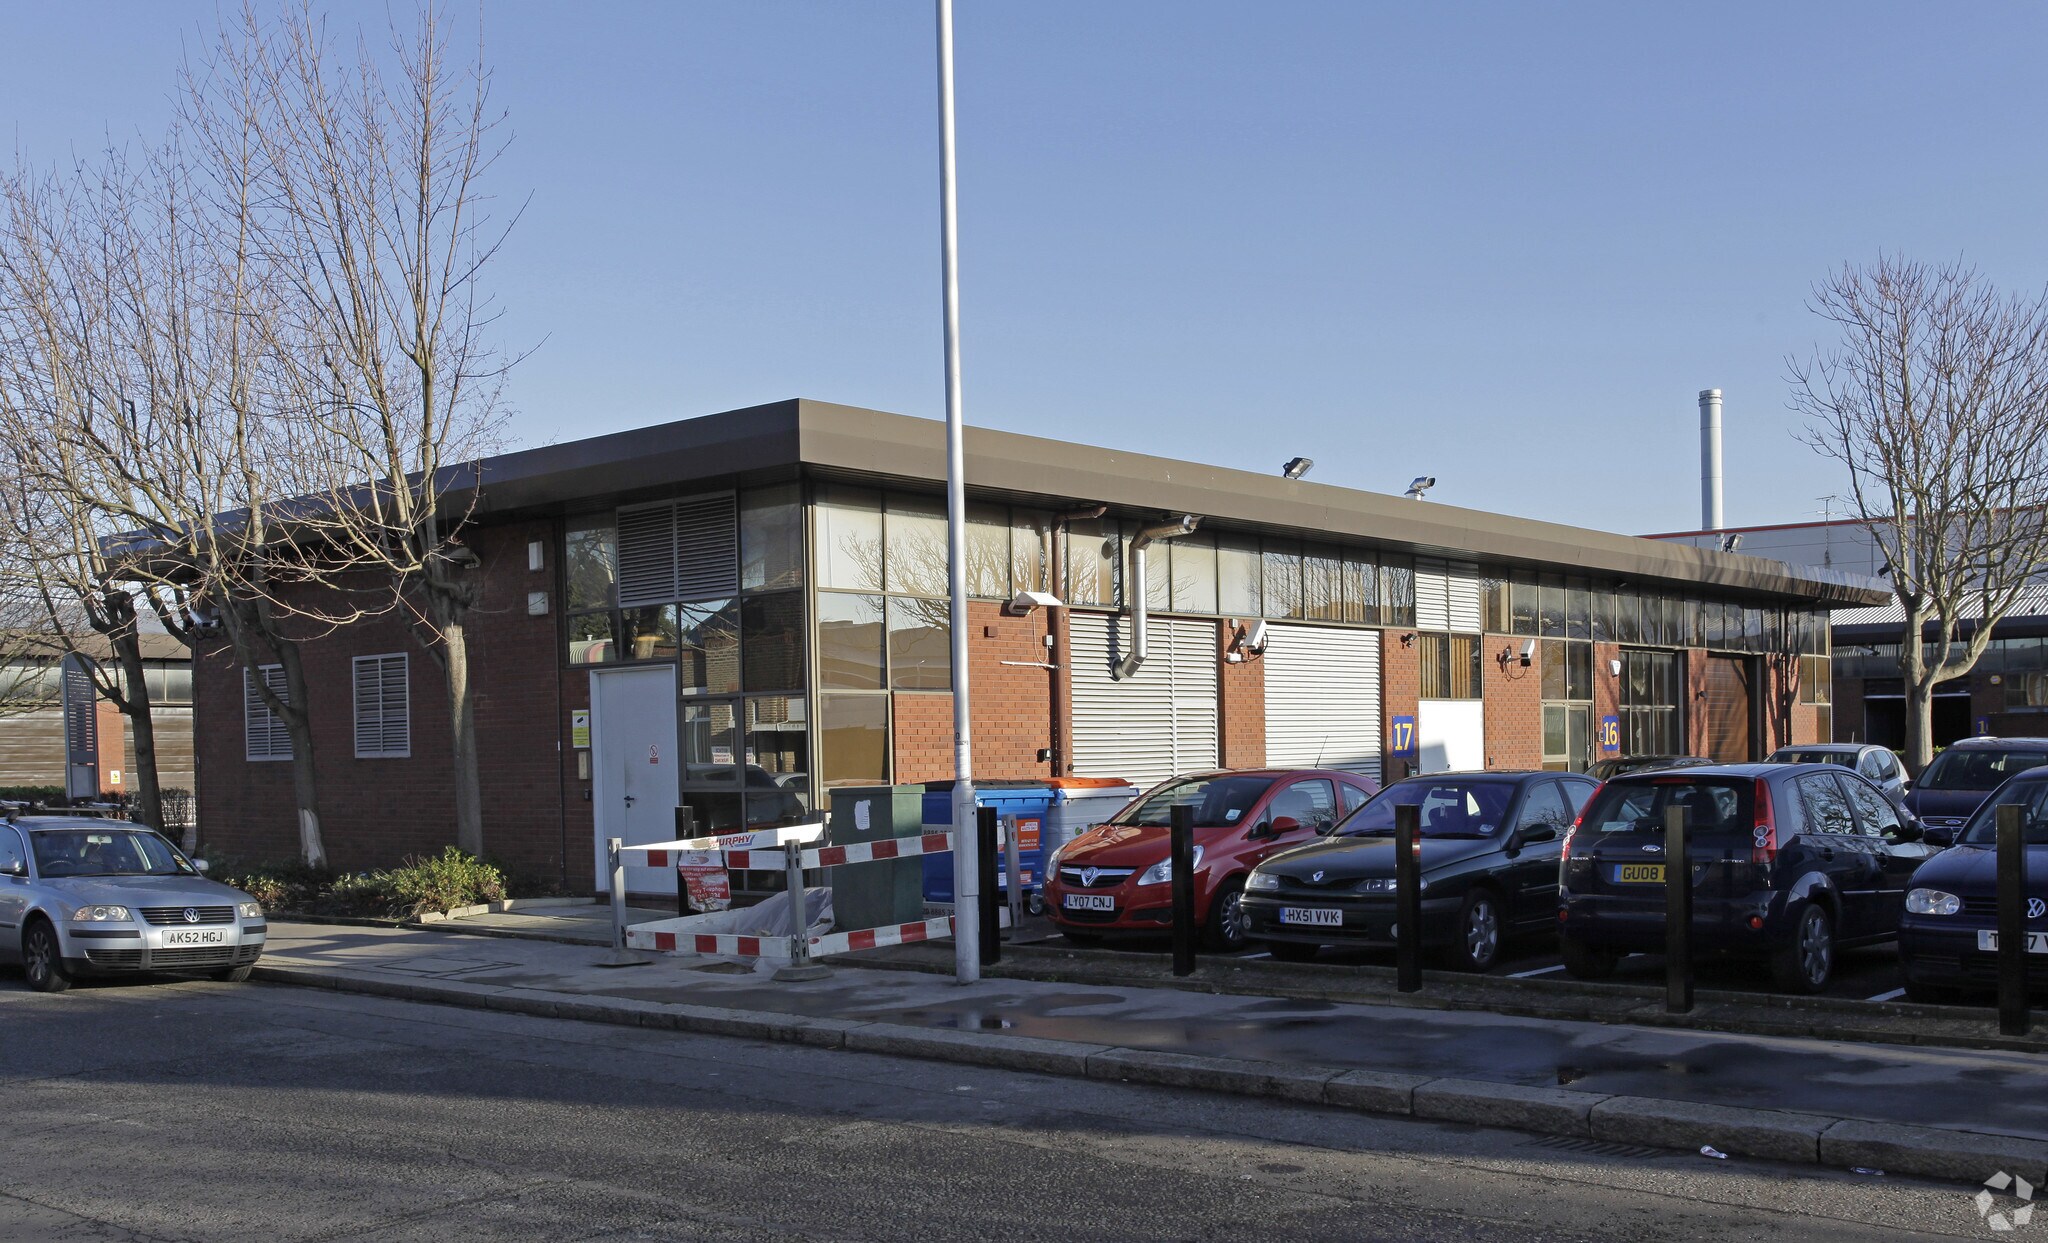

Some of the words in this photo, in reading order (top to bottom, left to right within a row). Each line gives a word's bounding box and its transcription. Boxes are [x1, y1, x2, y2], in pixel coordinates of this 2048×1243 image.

[1394, 723, 1413, 750] 17
[1603, 722, 1618, 745] 16
[1623, 867, 1658, 880] GU08
[1068, 896, 1090, 908] LY07
[1093, 897, 1112, 908] CNJ
[1288, 909, 1312, 922] HX51
[1315, 910, 1338, 923] VVK
[169, 932, 199, 943] AK52
[202, 932, 223, 942] HGJ
